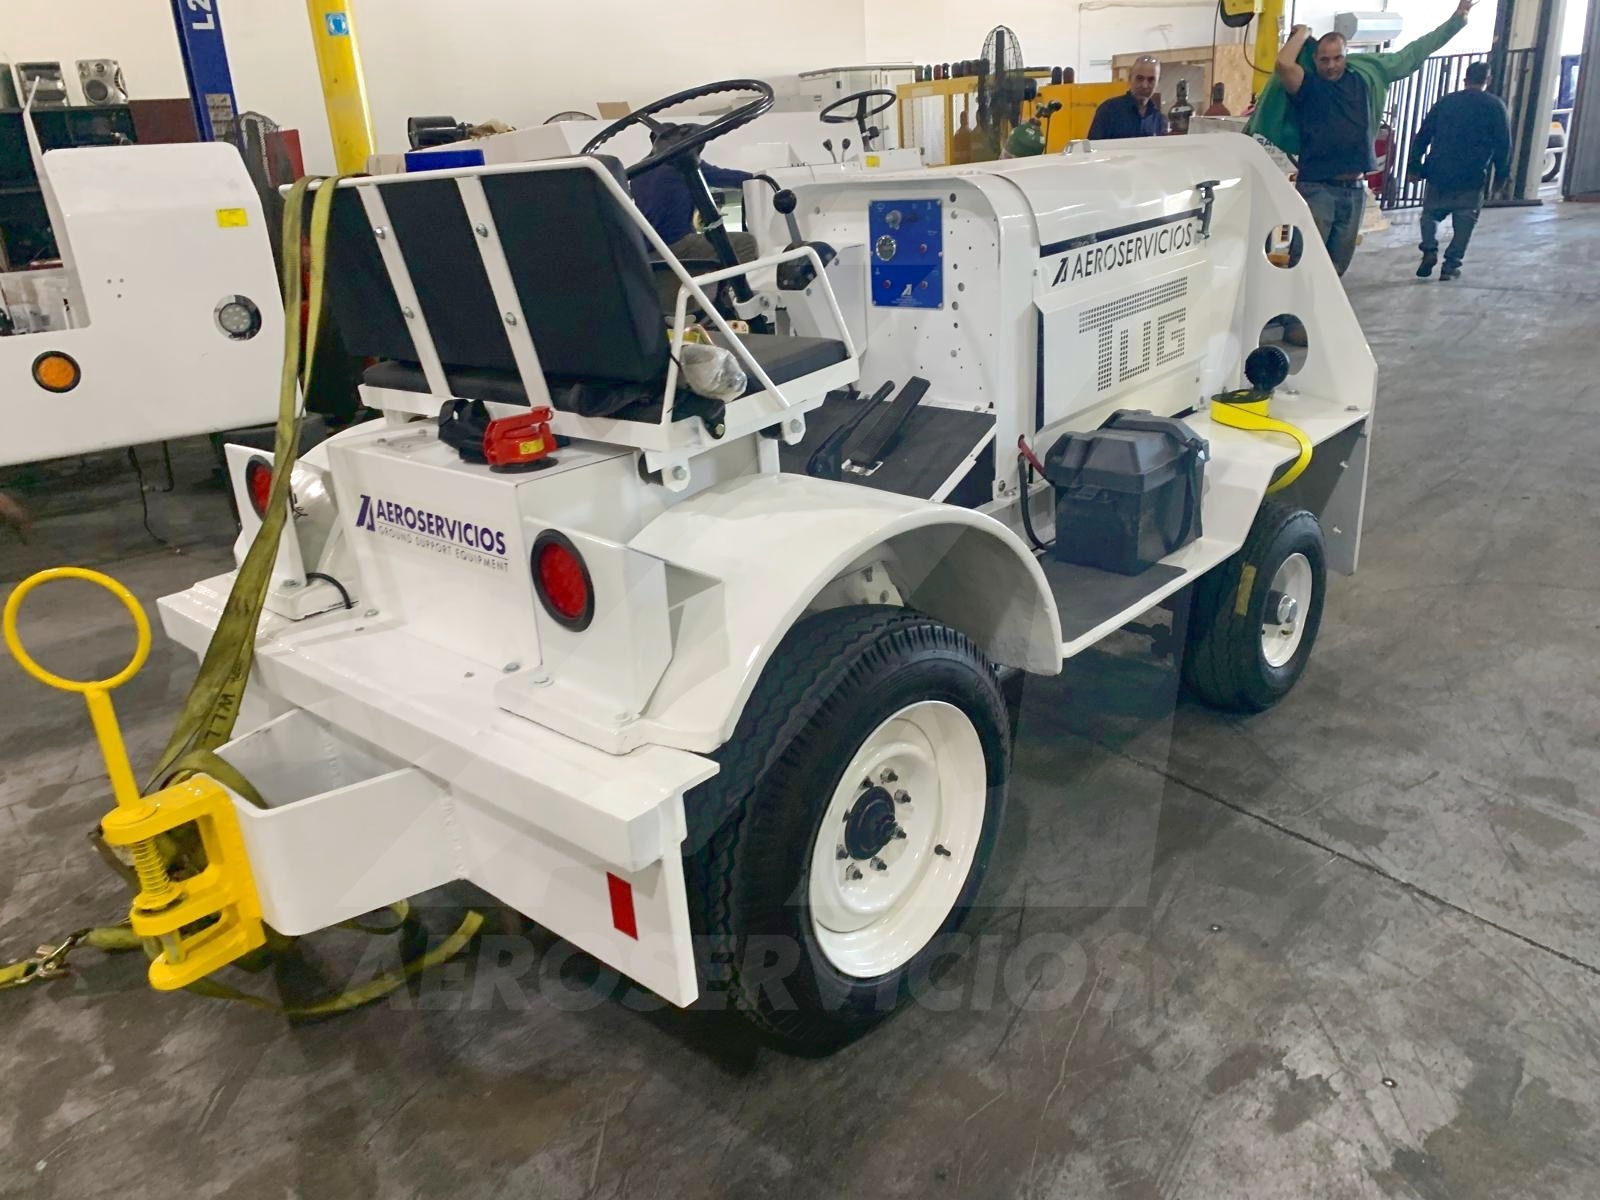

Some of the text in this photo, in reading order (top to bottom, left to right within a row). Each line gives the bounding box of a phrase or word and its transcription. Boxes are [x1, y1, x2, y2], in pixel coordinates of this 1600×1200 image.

[1071, 222, 1193, 282] AEROSERVICIOS
[1079, 276, 1188, 392] TUG
[376, 499, 507, 555] AEROSERVICIOS
[378, 525, 509, 573] GROUND SUPPORT EQUIPMENT
